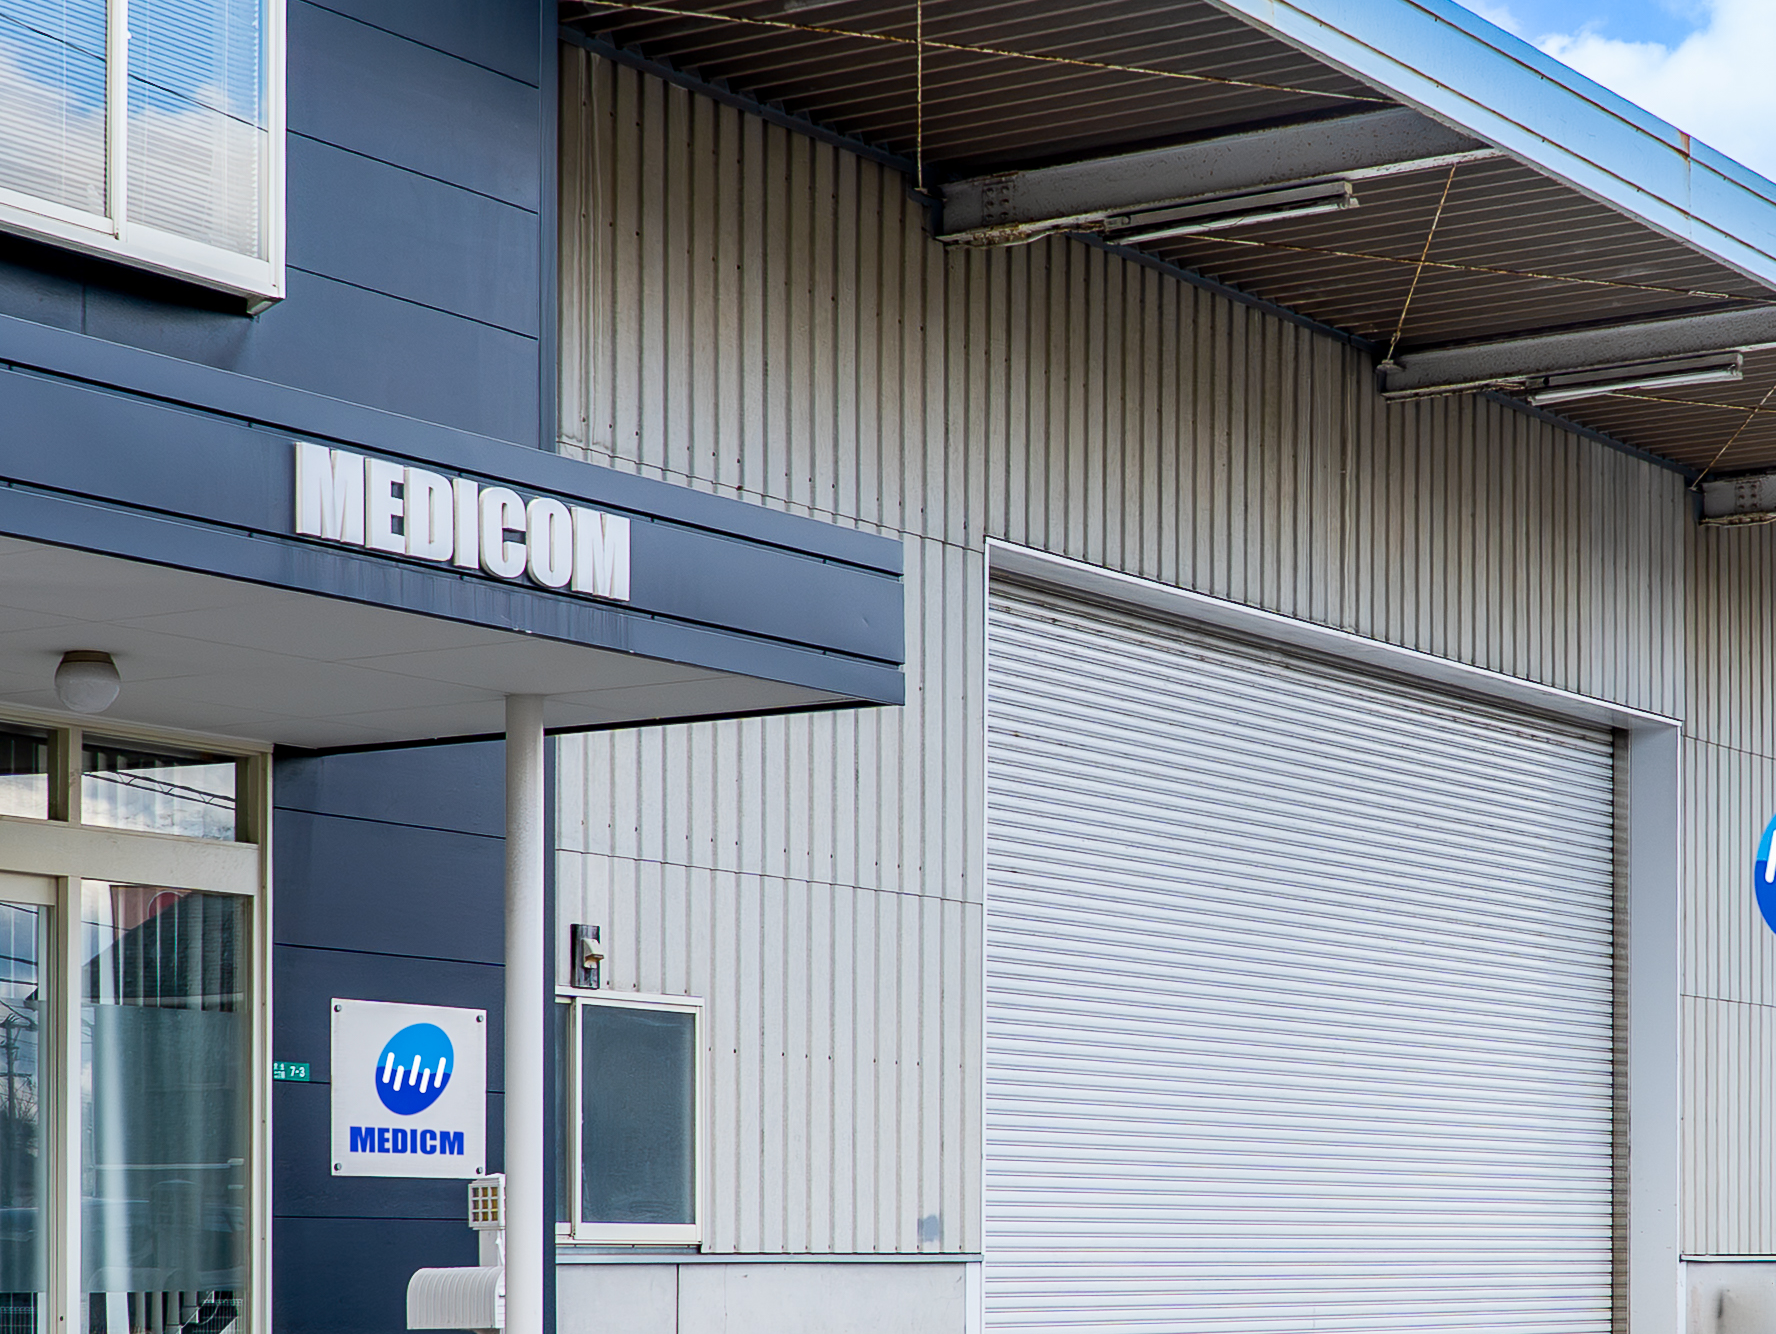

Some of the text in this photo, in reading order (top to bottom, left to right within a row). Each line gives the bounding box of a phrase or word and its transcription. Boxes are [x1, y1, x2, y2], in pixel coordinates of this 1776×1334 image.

[295, 441, 630, 602] MEDICOM
[290, 1065, 306, 1078] 7-3
[349, 1126, 464, 1156] MEDICM
